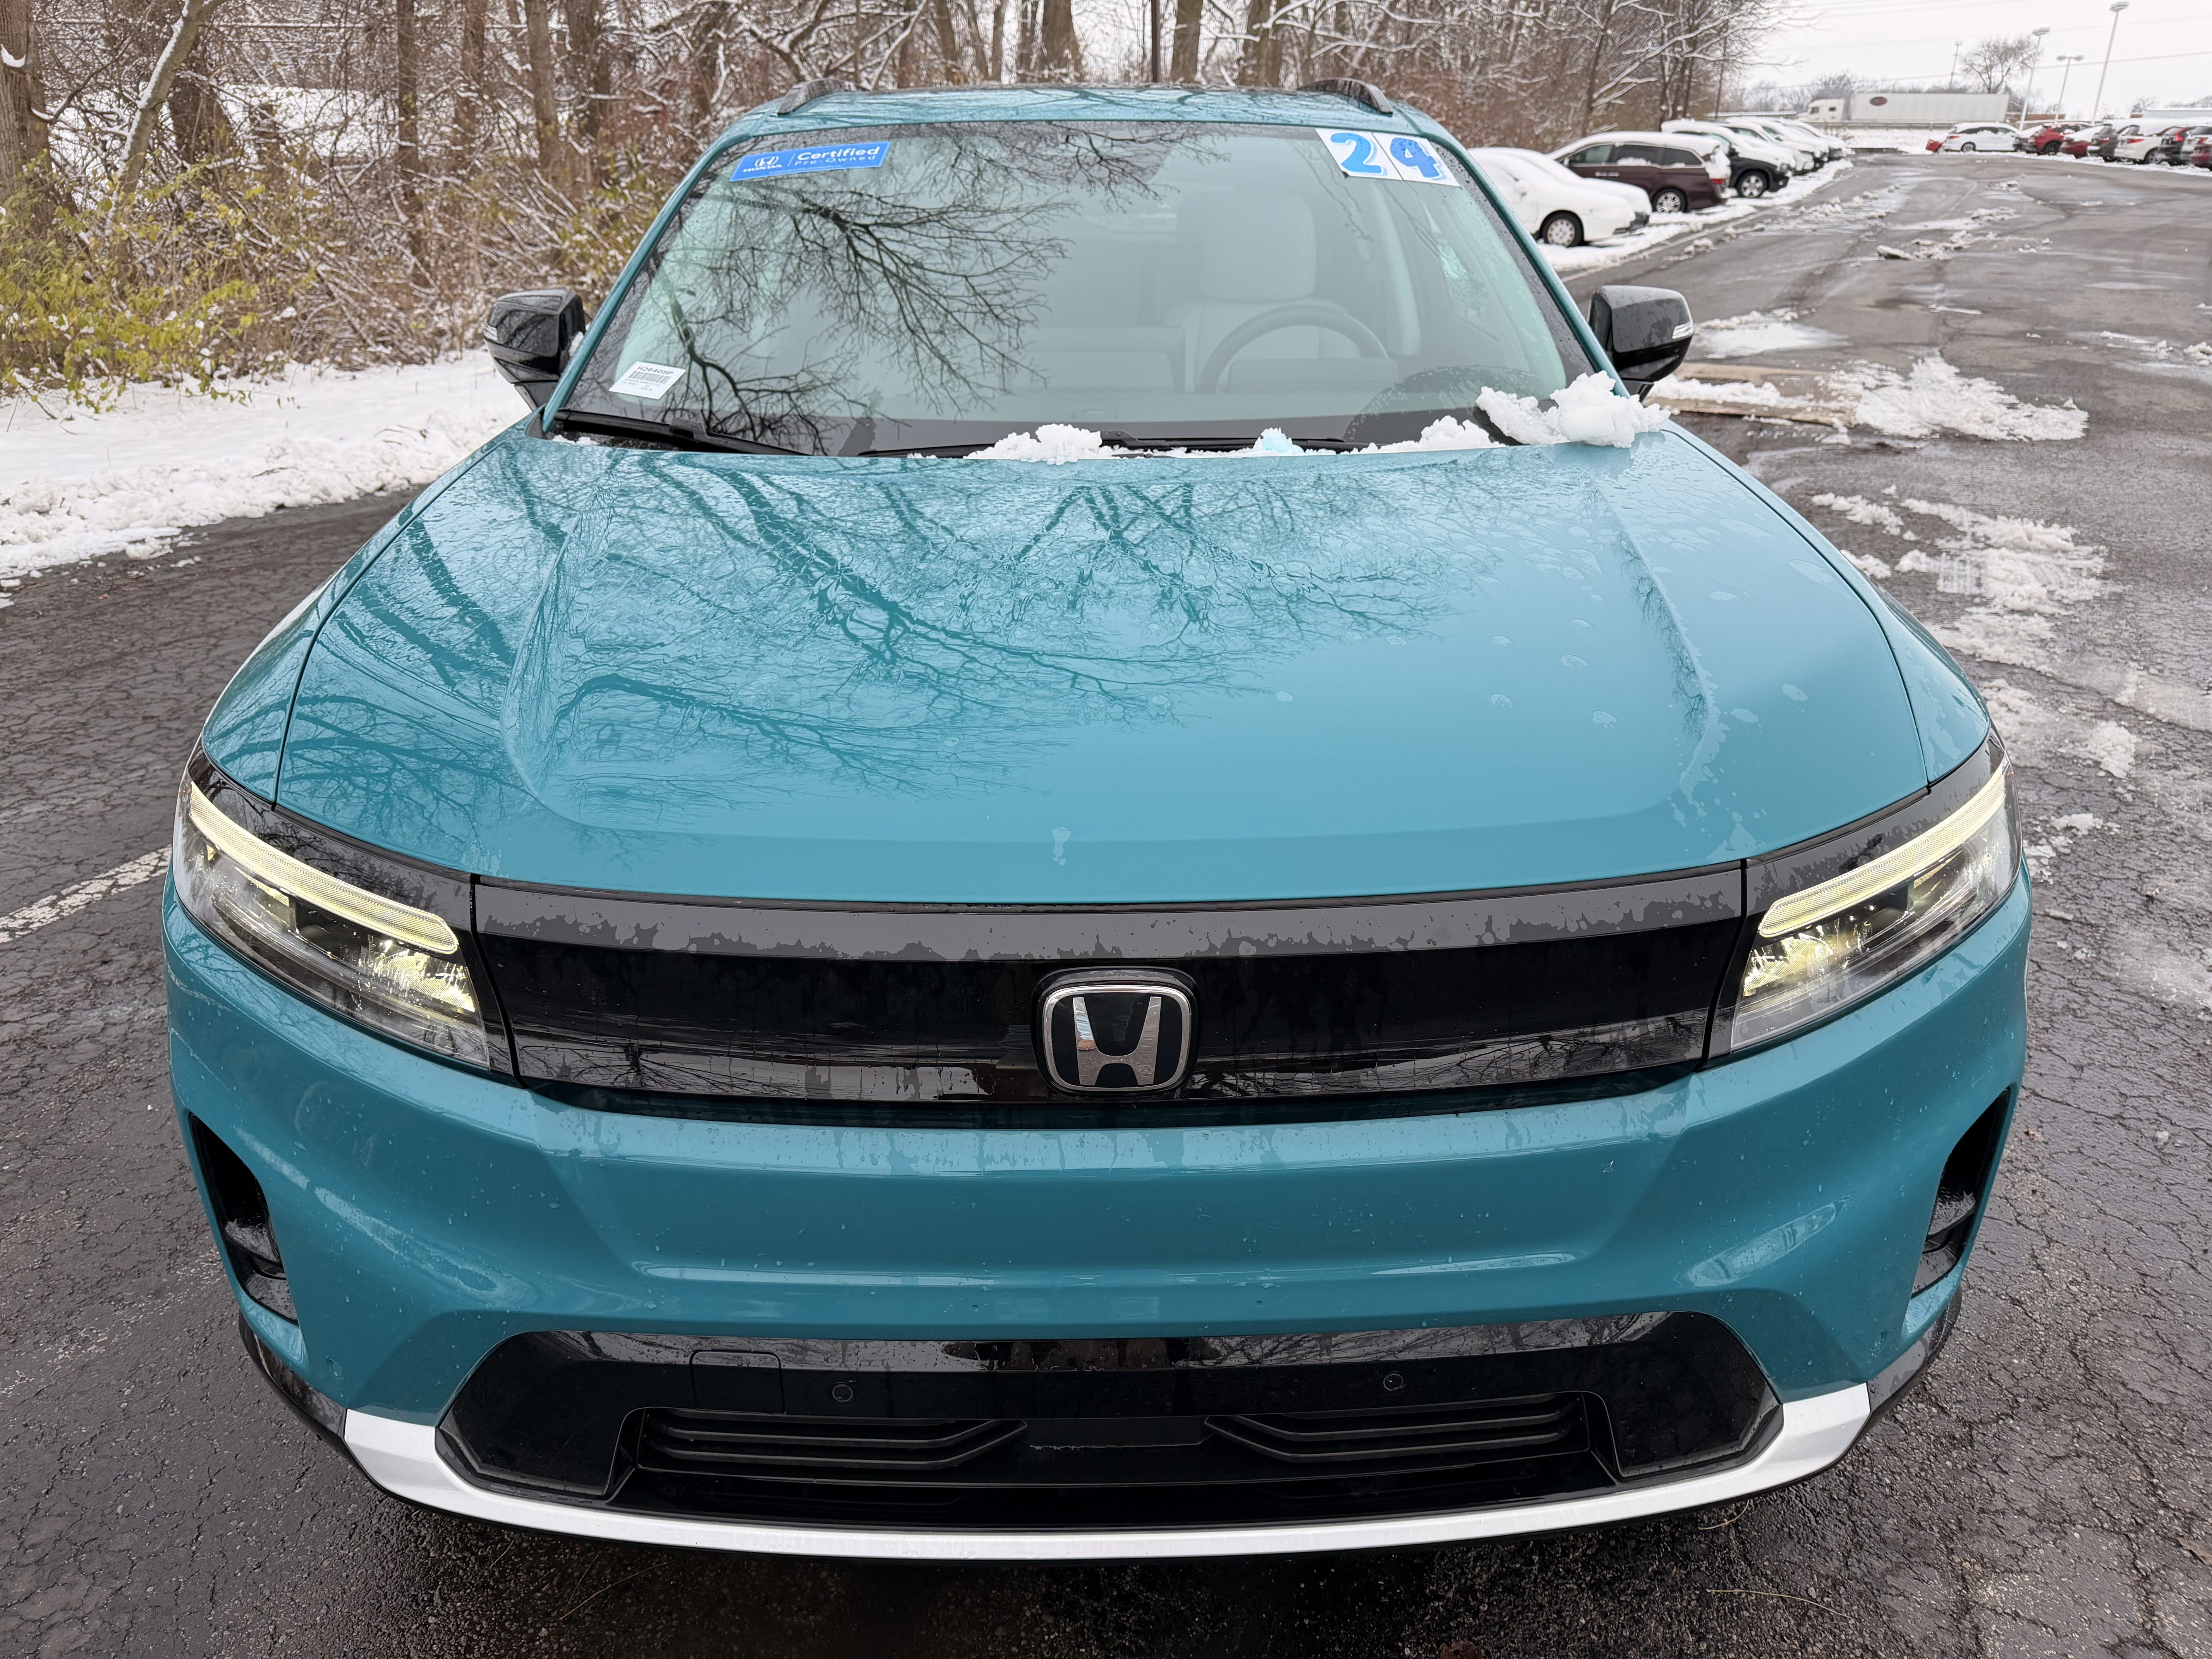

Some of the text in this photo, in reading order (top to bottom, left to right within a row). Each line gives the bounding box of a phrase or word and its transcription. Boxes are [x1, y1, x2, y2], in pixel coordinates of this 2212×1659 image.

[797, 146, 880, 160] Certified
[794, 155, 876, 166] Pre-Owned
[743, 164, 783, 173] HONDA
